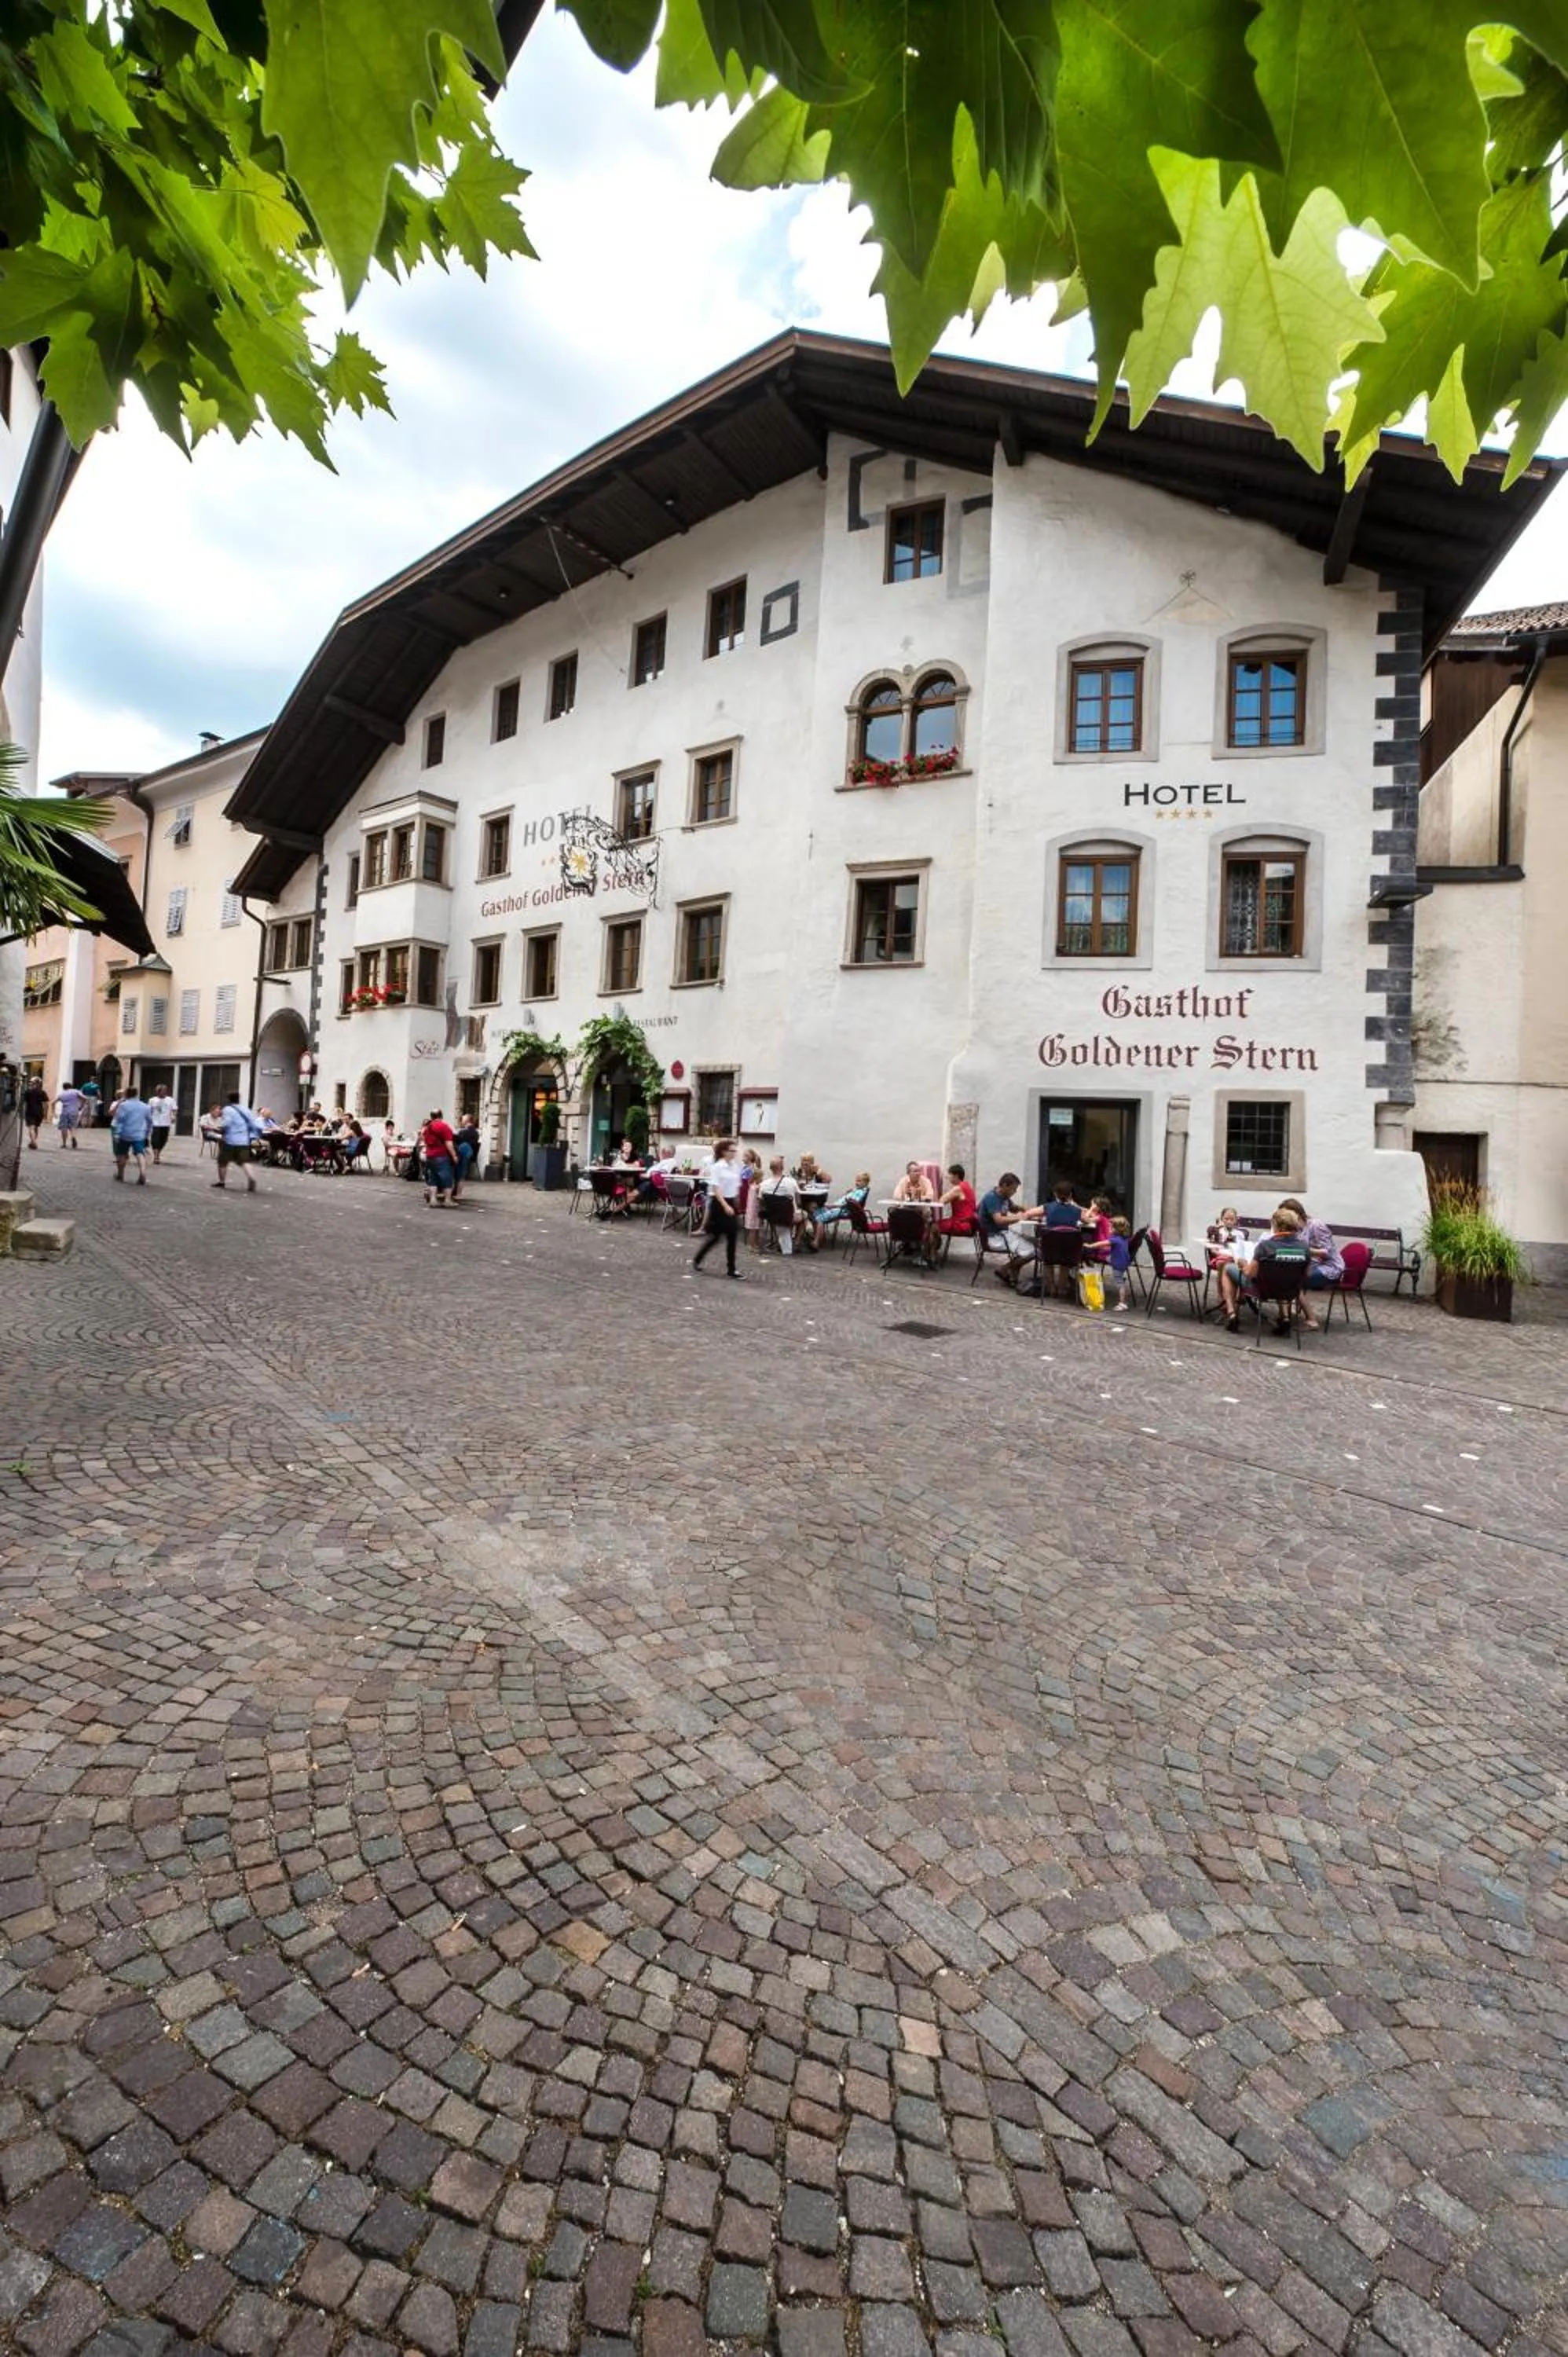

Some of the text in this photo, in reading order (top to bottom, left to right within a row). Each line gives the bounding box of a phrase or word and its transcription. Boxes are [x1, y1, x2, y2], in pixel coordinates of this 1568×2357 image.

[1124, 783, 1246, 806] HOTEL
[482, 889, 529, 917] Gasthof
[532, 878, 593, 906] Golden
[1101, 984, 1255, 1021] Gasthof
[1039, 1033, 1319, 1070] Goldener Stern
